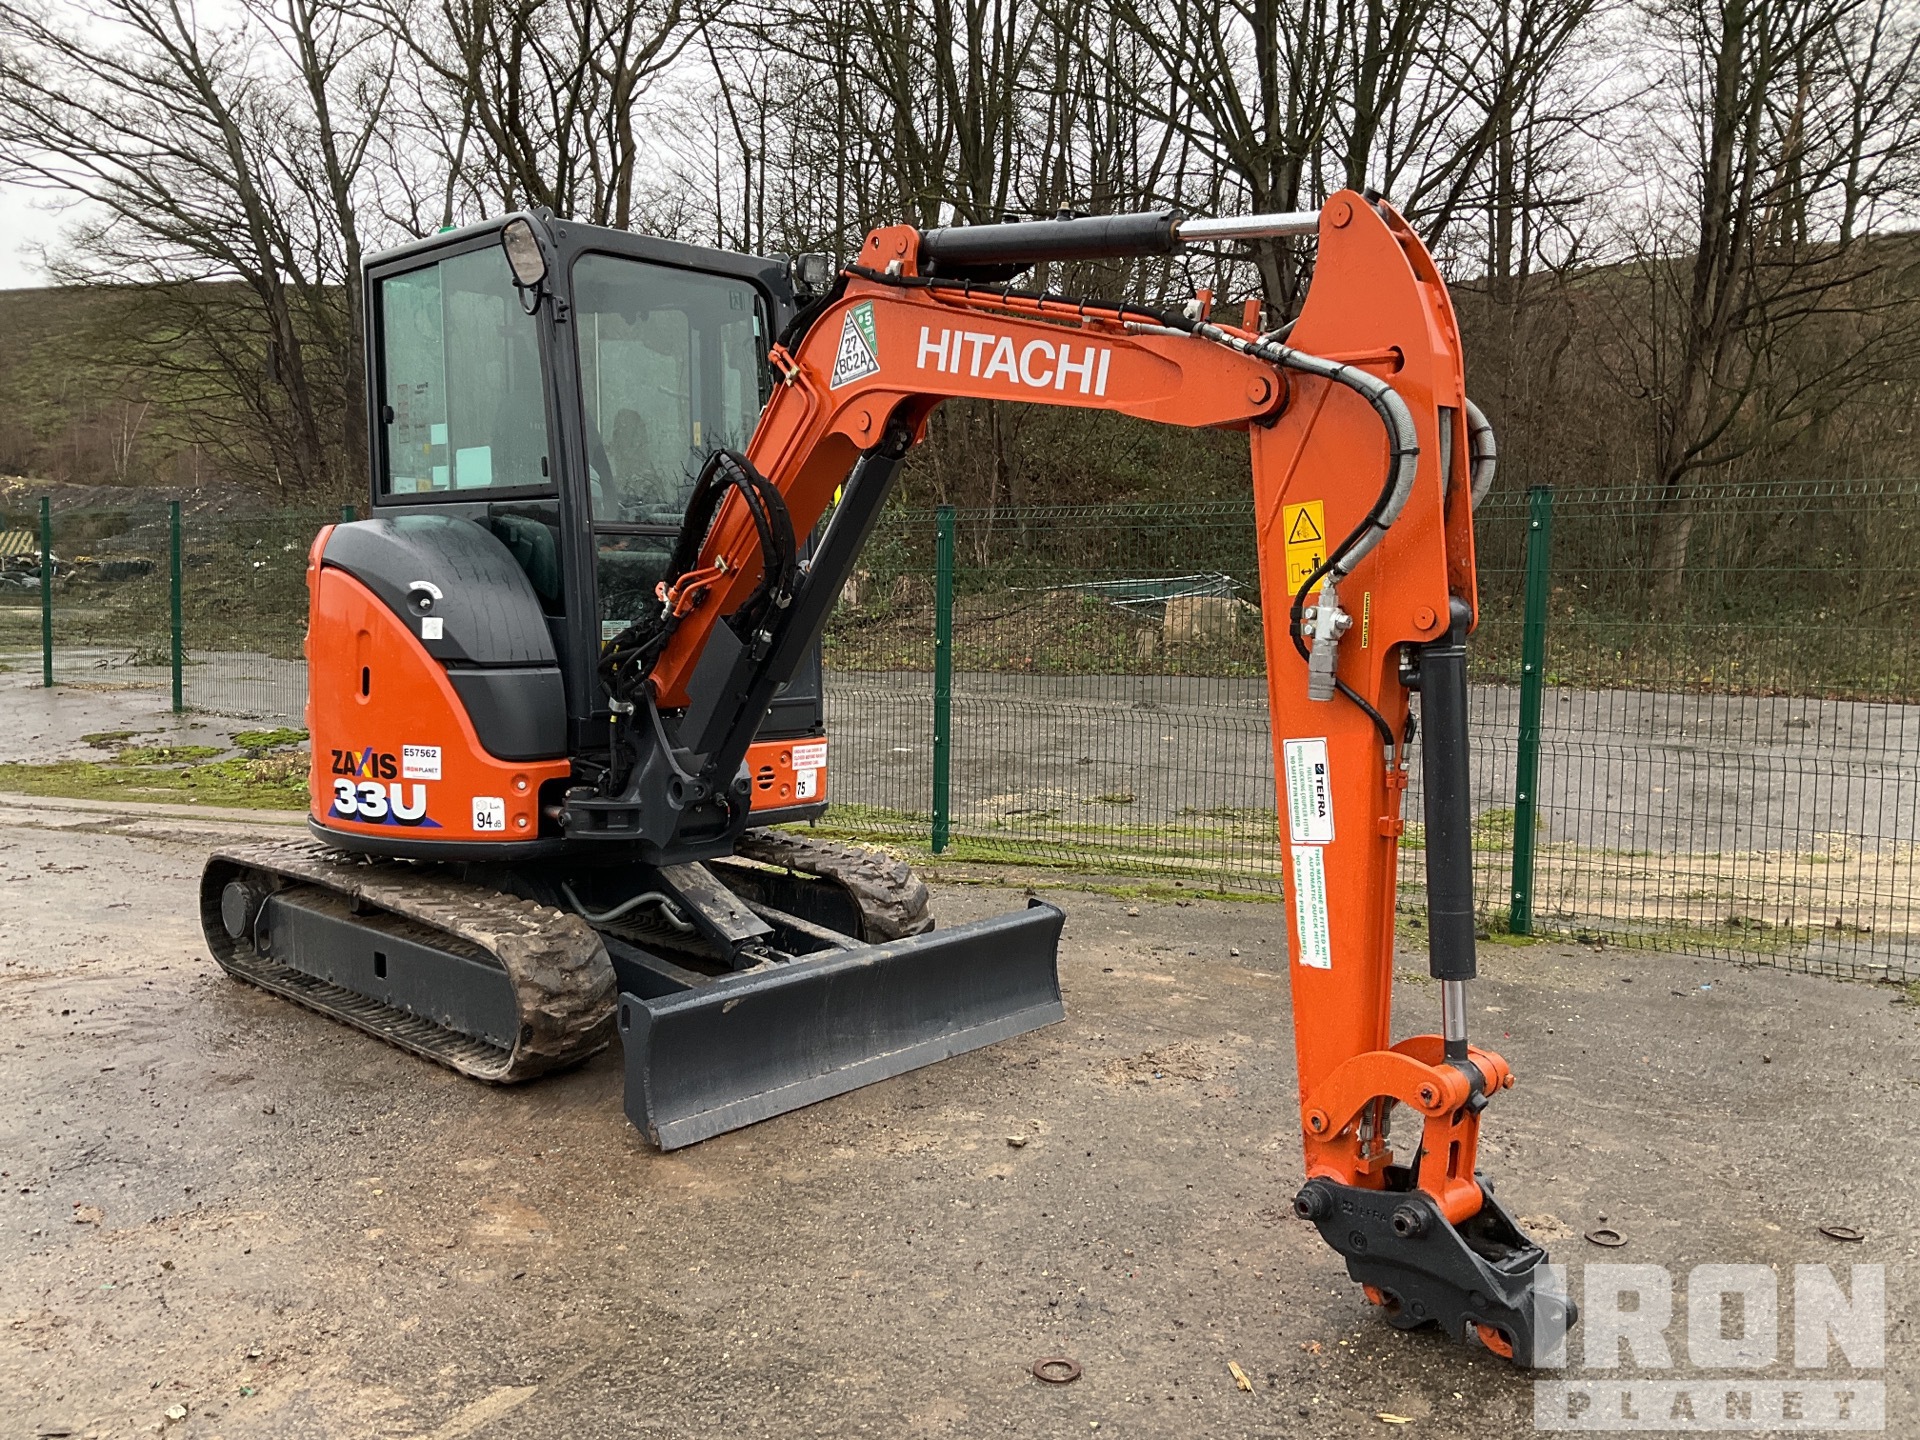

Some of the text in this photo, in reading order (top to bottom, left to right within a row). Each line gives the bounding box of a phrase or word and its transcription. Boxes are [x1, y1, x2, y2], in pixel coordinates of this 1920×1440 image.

[864, 311, 872, 326] 5
[845, 335, 857, 355] 27
[839, 350, 867, 375] BC2A
[916, 326, 1111, 396] HITACHI
[331, 747, 397, 779] ZAXIS
[404, 748, 437, 758] E57562
[1297, 745, 1305, 767] DOUBLE
[798, 781, 806, 796] 75
[1290, 755, 1296, 764] NO
[1293, 798, 1301, 827] REQUIRED
[1298, 768, 1306, 792] LOCKING
[334, 778, 427, 825] 33U
[1300, 792, 1308, 817] COUPLER
[1316, 776, 1325, 818] TEFRA
[477, 812, 492, 828] 94
[1295, 854, 1302, 866] NO
[1296, 868, 1304, 898] SAFETY
[1308, 856, 1316, 902] AUTOMATIC
[1318, 907, 1324, 915] IS
